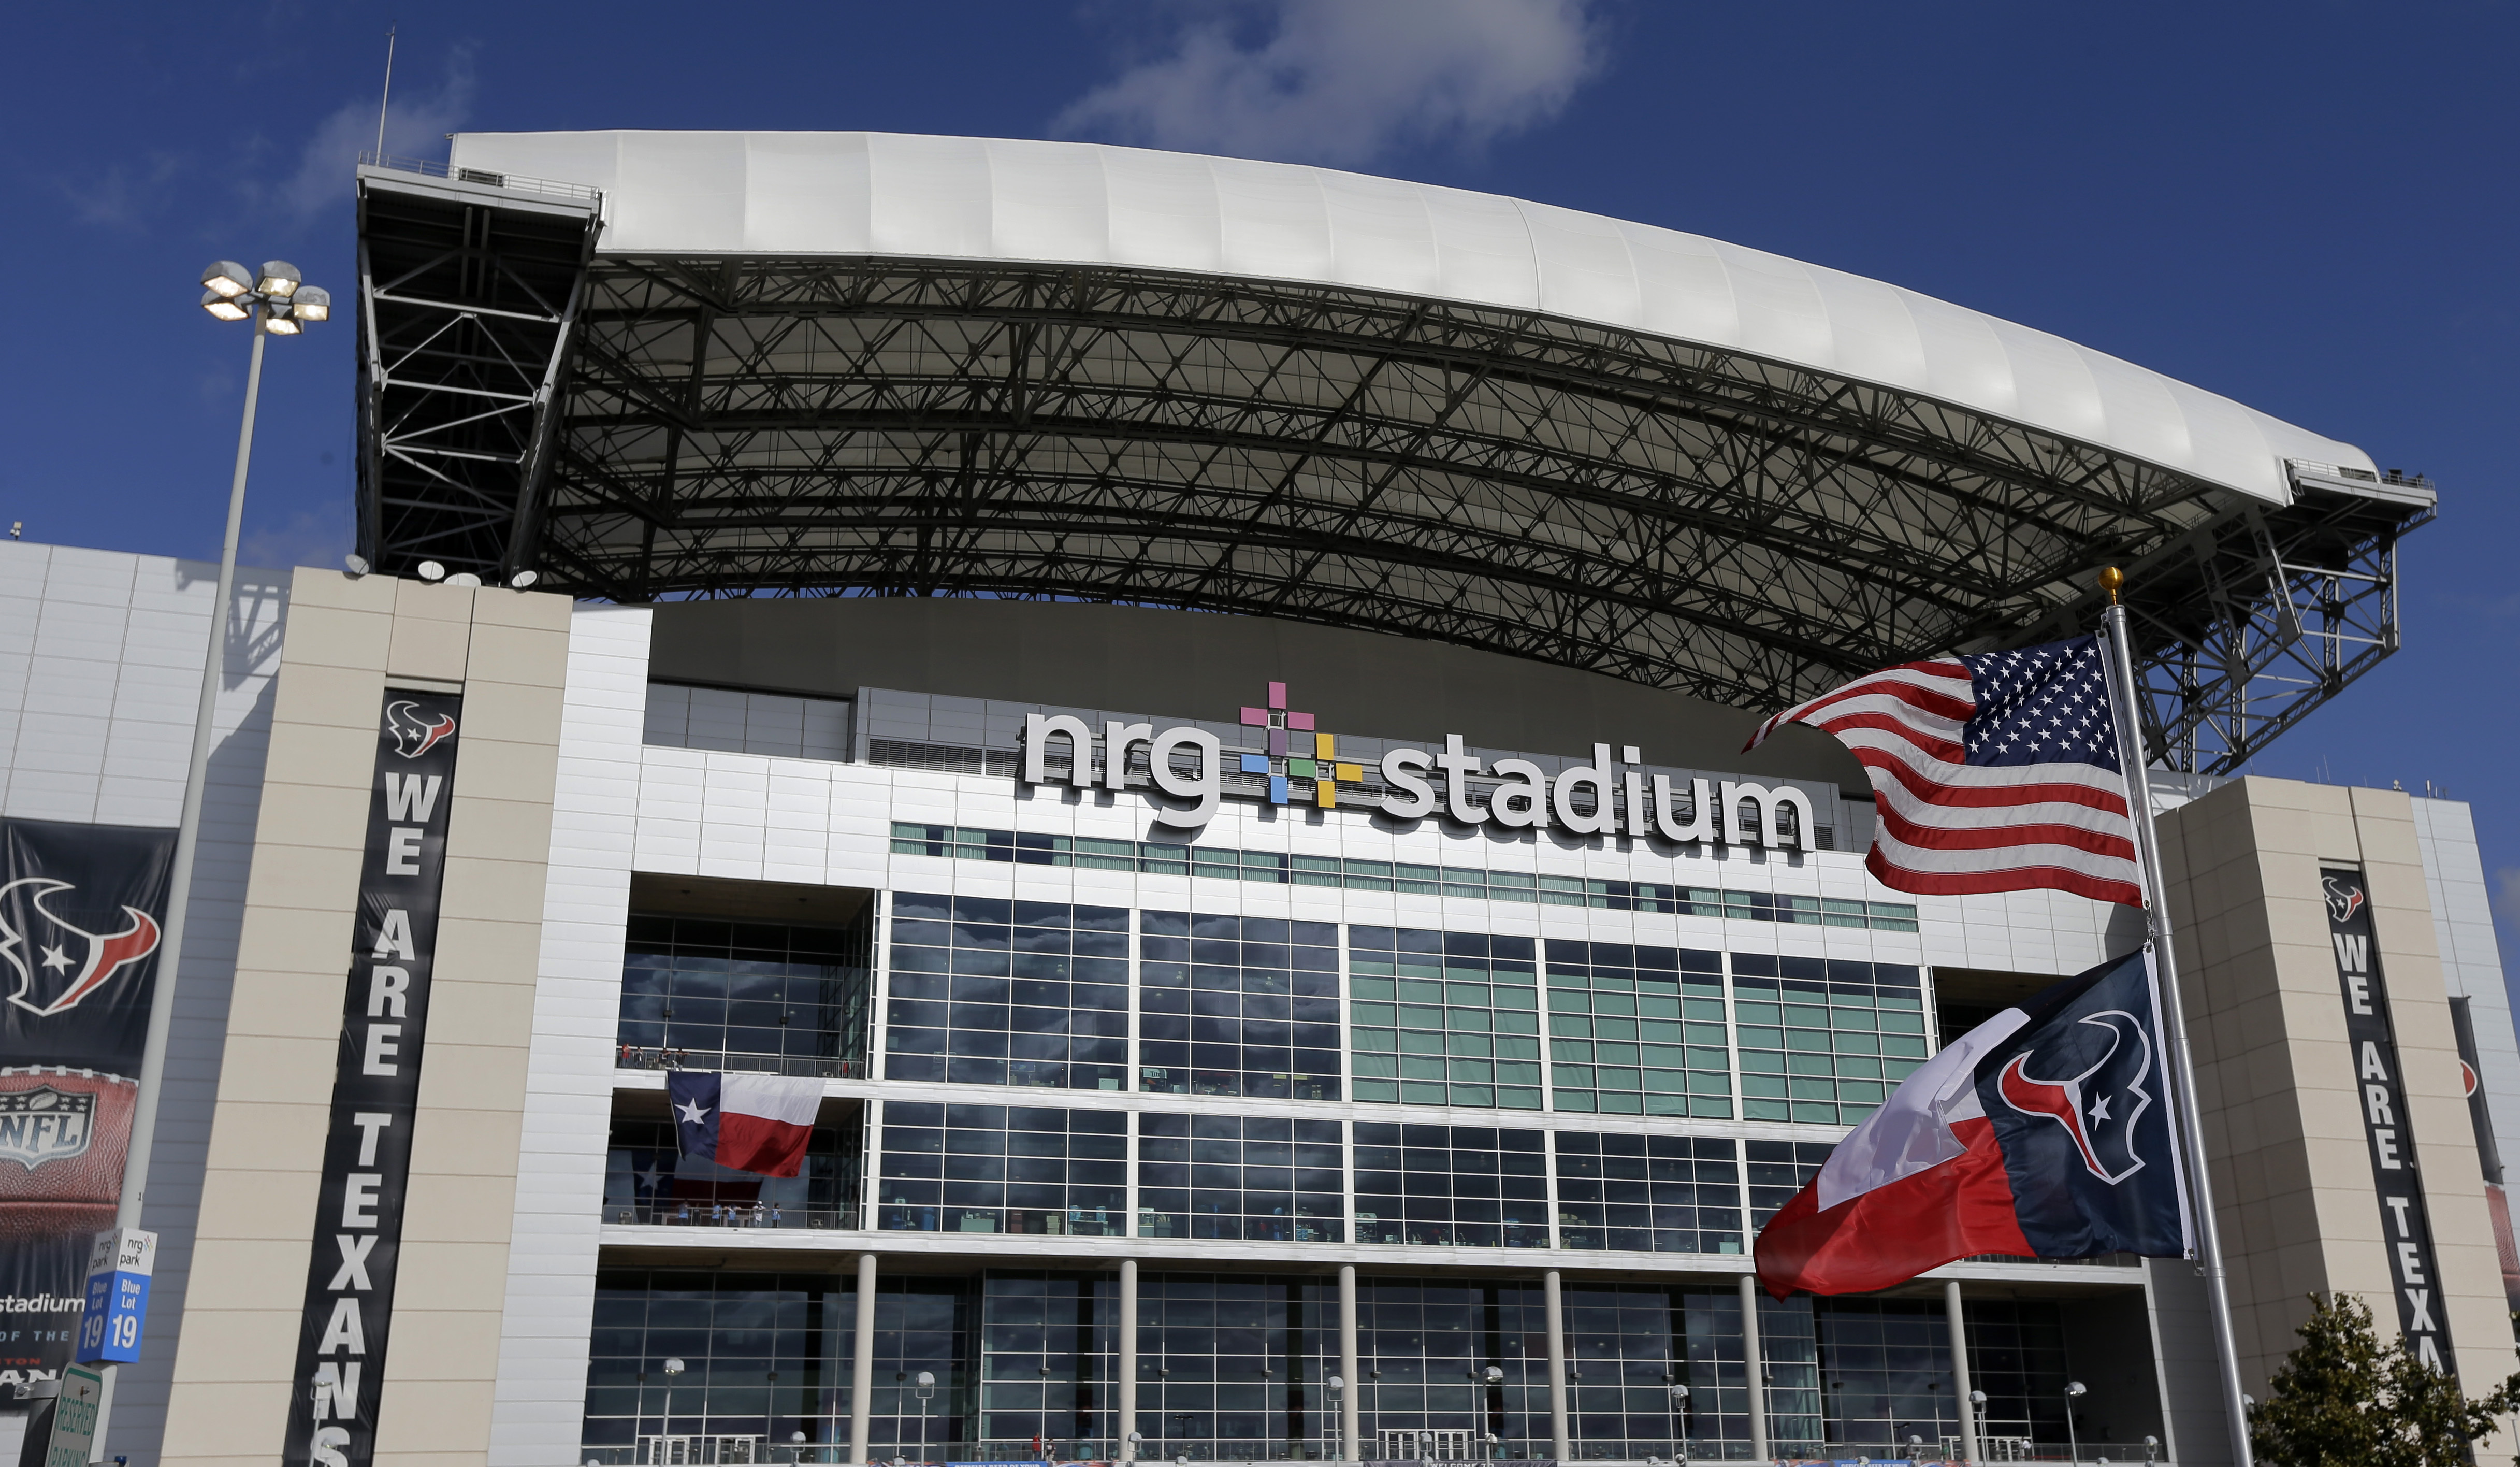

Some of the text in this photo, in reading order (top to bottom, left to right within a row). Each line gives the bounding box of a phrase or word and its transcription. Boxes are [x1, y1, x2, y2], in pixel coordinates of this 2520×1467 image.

[1025, 713, 1816, 851] nrg stadium
[2333, 933, 2373, 1016] WE
[2362, 1041, 2401, 1170] ARE
[310, 771, 443, 1467] WE ARE TEXANS
[0, 1115, 77, 1153] NFL
[99, 1240, 111, 1253] nrg
[127, 1238, 144, 1253] nrg
[92, 1256, 108, 1271] park
[119, 1254, 141, 1267] park
[92, 1281, 108, 1295] Blue
[121, 1278, 141, 1295] Blue
[91, 1298, 103, 1311] Lot
[121, 1295, 136, 1310] Lot
[33, 1331, 69, 1342] THE
[83, 1314, 104, 1349] 19
[112, 1313, 138, 1349] 19
[0, 1358, 41, 1366] TON
[56, 1397, 96, 1436] RESERVED
